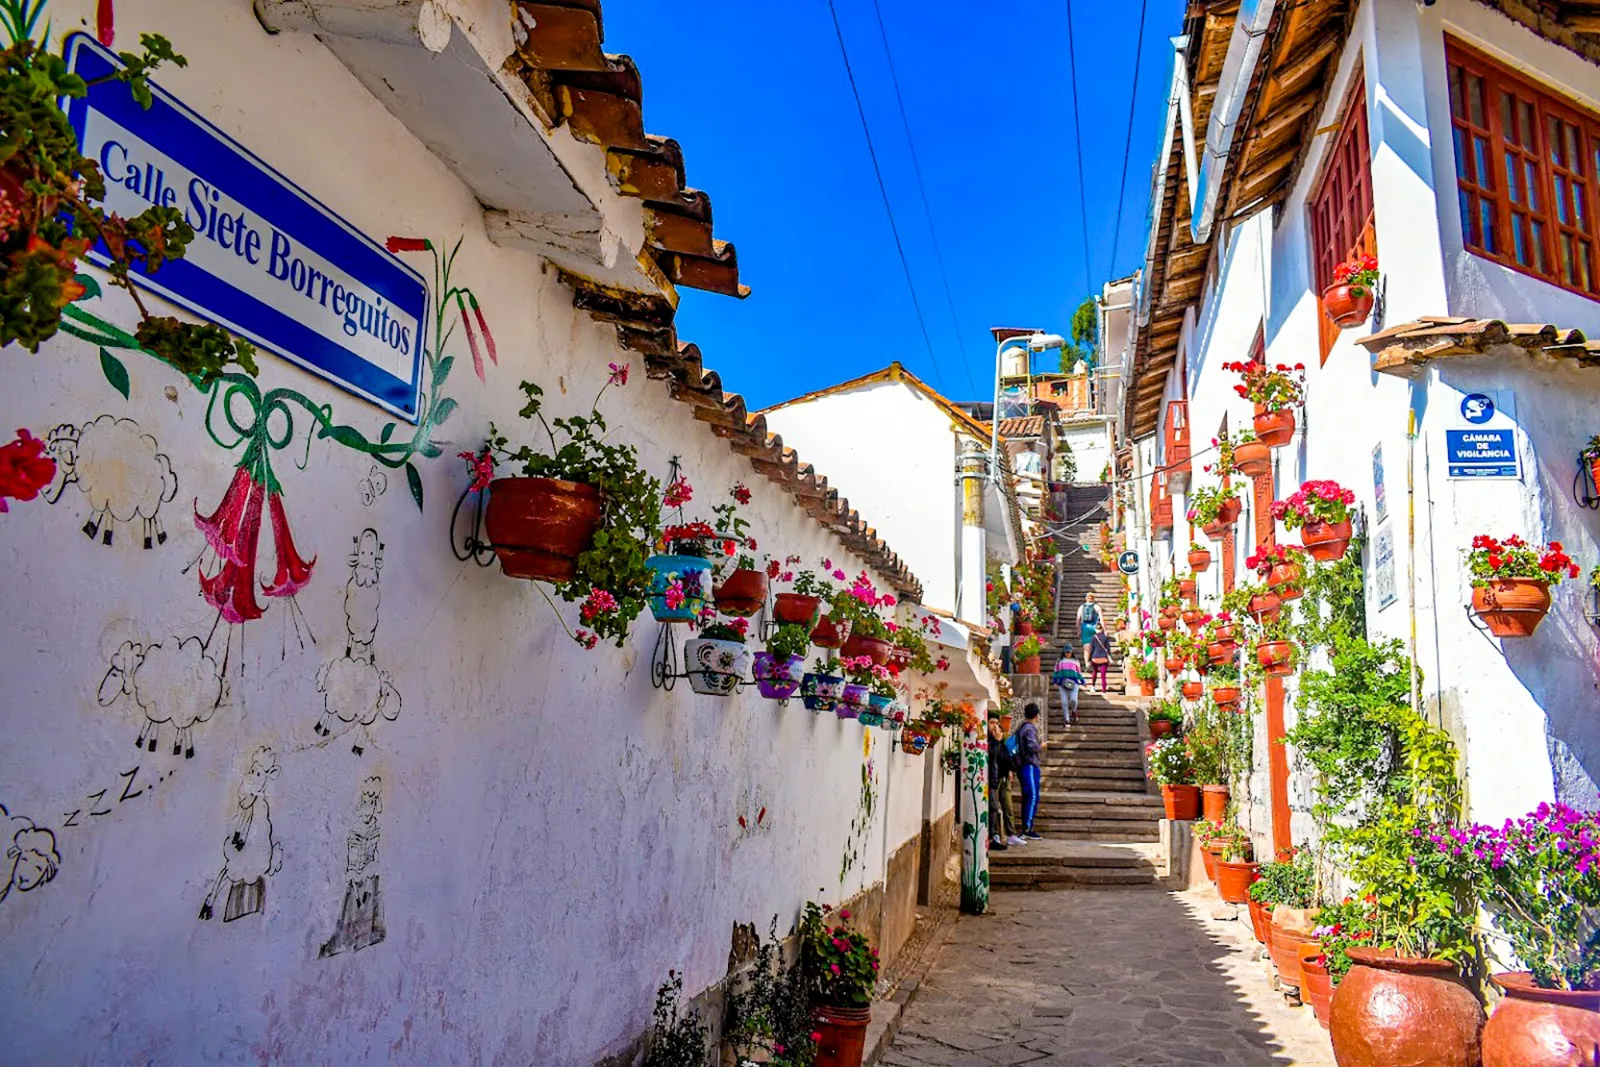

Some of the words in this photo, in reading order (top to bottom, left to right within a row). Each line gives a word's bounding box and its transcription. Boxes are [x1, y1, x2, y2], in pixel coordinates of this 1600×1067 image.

[100, 141, 176, 209] Calle
[184, 178, 261, 265] Siete
[265, 227, 410, 355] Borreguitos
[1462, 433, 1502, 442] CÁMARA
[1476, 442, 1490, 450] DE
[1456, 449, 1511, 458] VIGILANCIA
